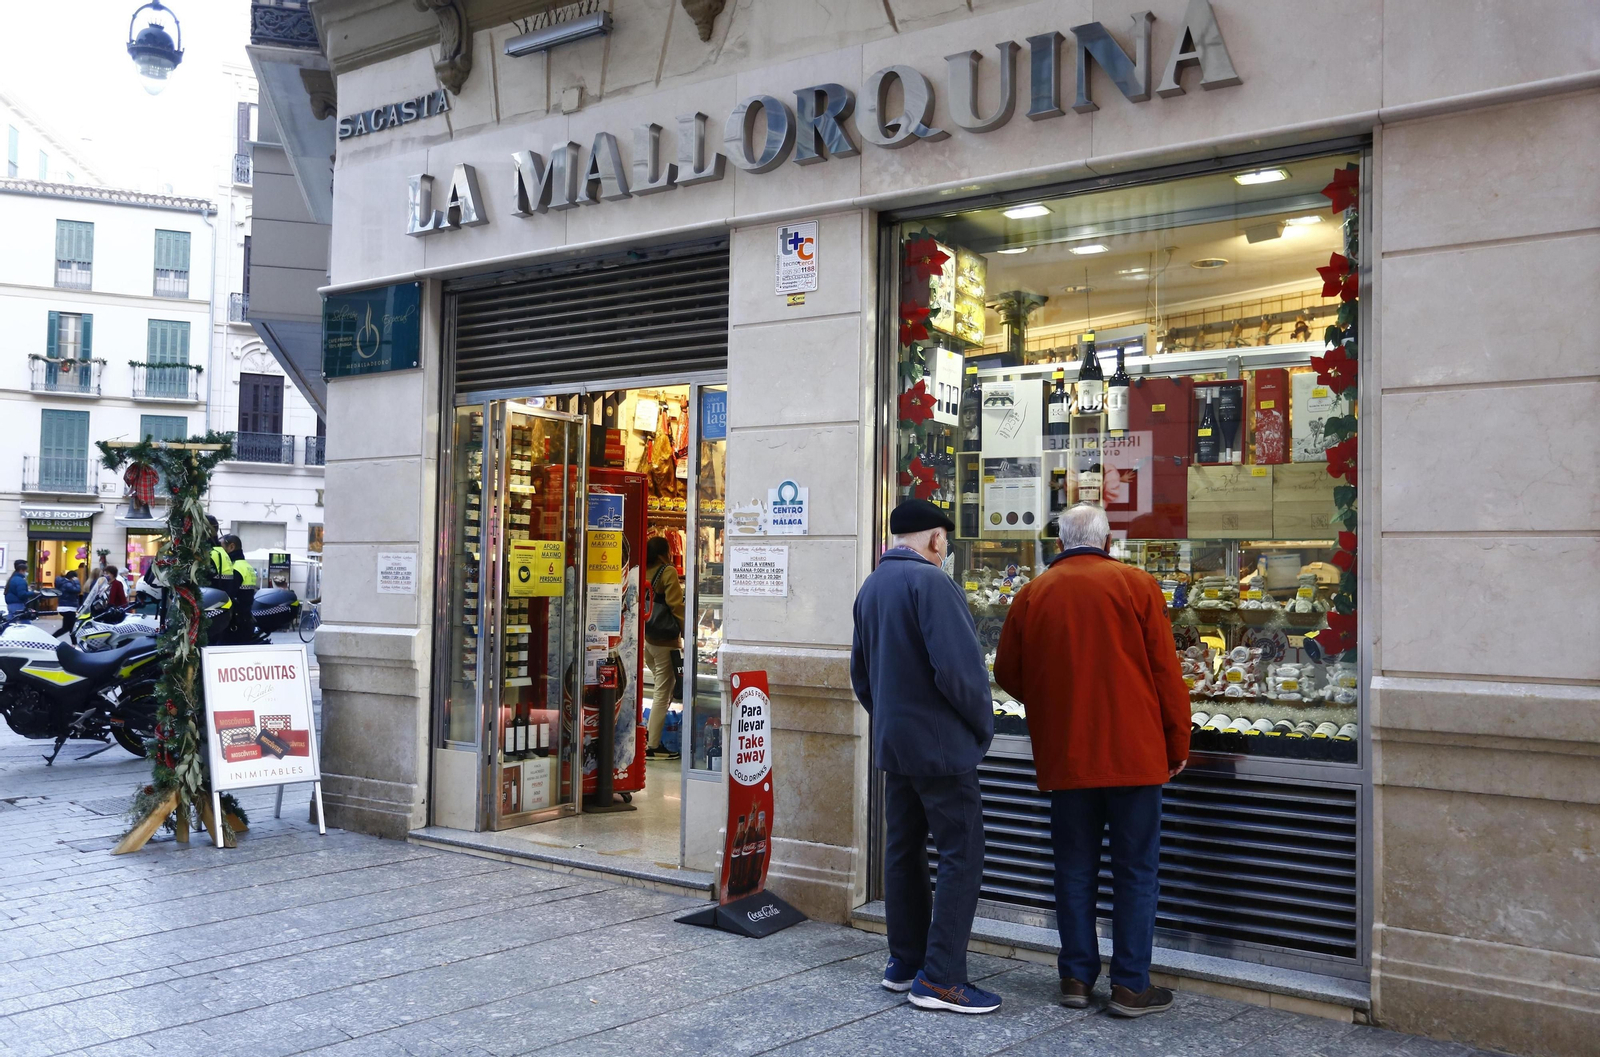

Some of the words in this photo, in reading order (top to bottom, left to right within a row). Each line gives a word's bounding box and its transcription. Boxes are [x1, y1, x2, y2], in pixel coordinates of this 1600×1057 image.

[338, 88, 452, 141] SAGASTA
[405, 162, 490, 238] LA
[511, 0, 1243, 218] MALLORQUINA
[706, 410, 727, 428] lag
[24, 510, 55, 518] YVES
[772, 506, 803, 514] CENTRO
[772, 517, 803, 526] MÁLAGA
[601, 551, 608, 561] 6
[548, 562, 554, 573] 6
[217, 664, 296, 683] MOSCOVITAS
[735, 689, 755, 708] BEBIDAS
[741, 704, 762, 718] Para
[737, 719, 765, 733] llevar
[738, 734, 764, 750] Take
[736, 749, 766, 765] away
[230, 765, 304, 781] INIMITABLES
[734, 768, 748, 782] COLD
[748, 764, 768, 782] DRINKS
